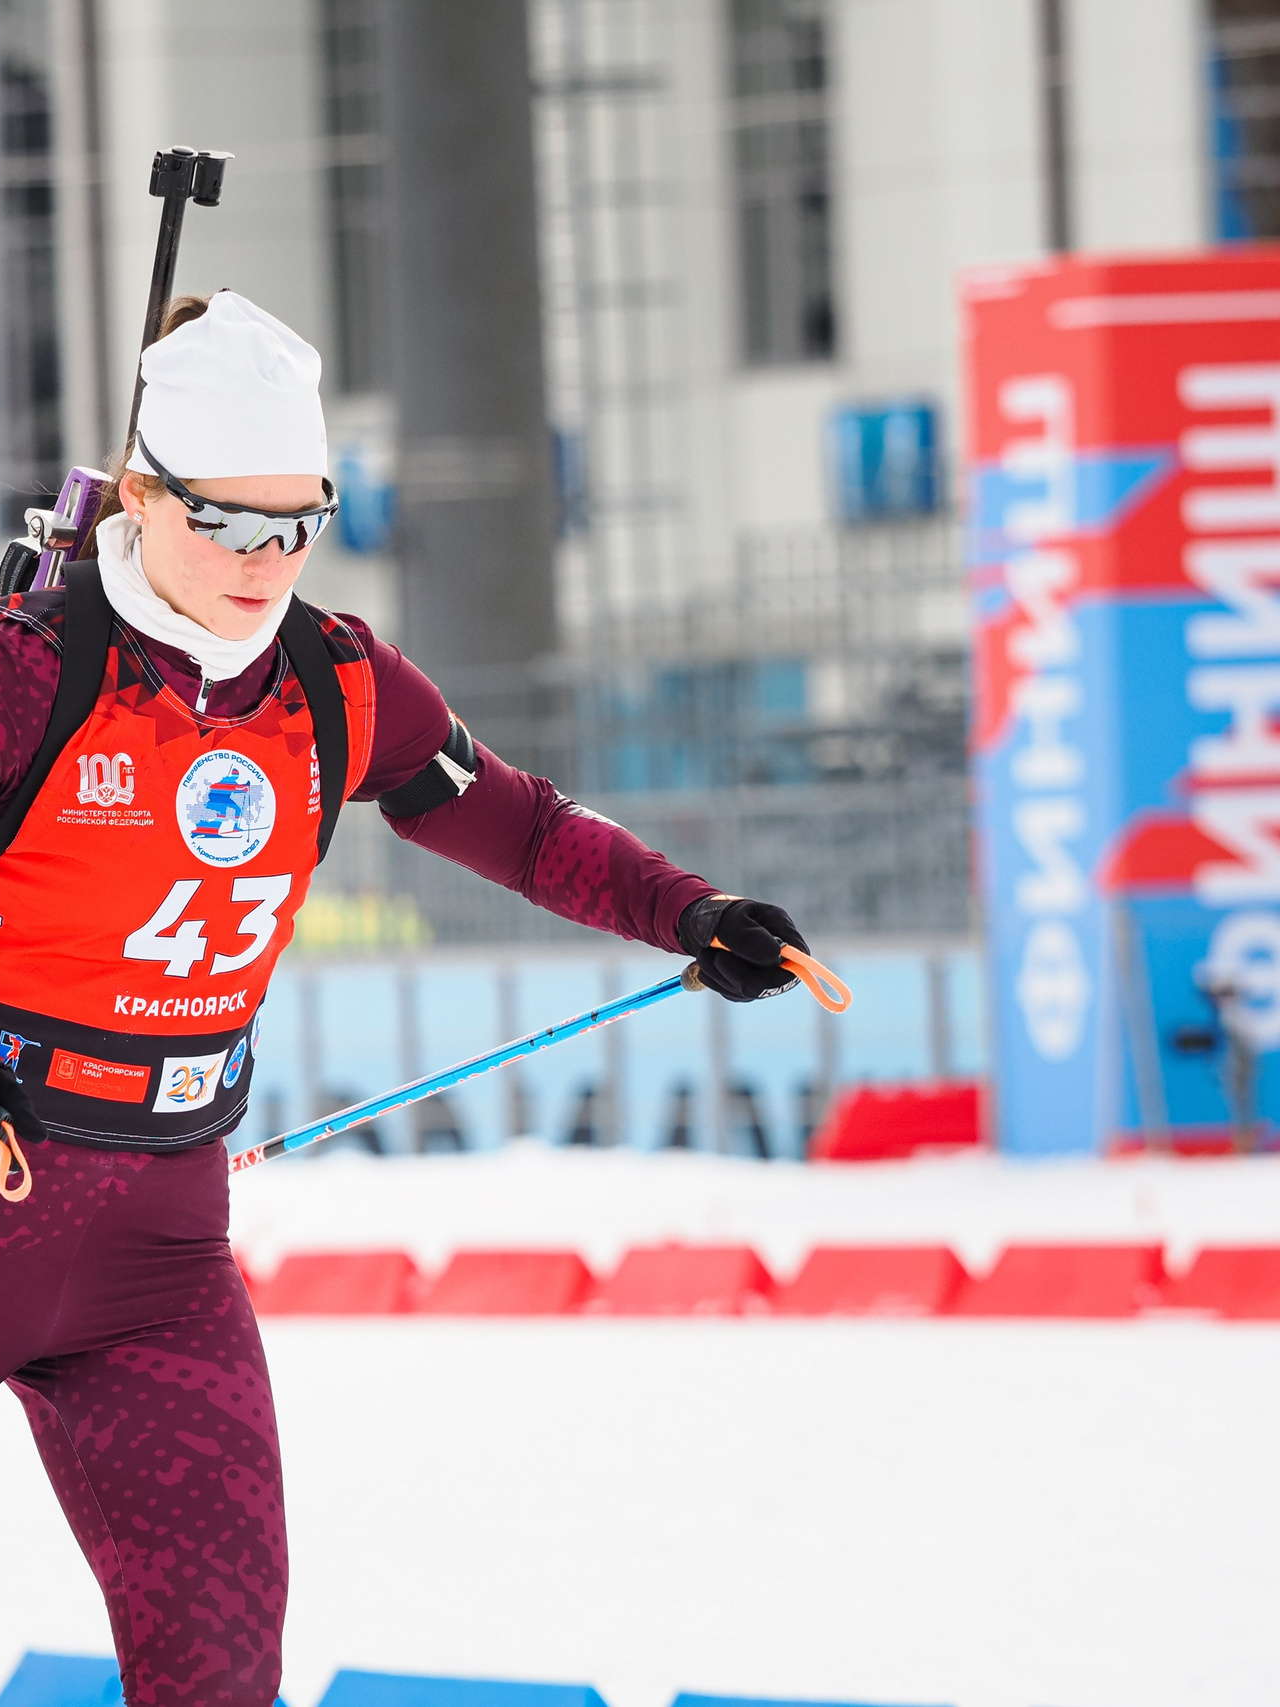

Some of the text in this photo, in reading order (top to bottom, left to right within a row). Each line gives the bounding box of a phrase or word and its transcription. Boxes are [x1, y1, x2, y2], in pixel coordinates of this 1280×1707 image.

[182, 752, 265, 788] ПЕРВЕНСТВО РОССИИ
[56, 816, 154, 826] РОССИЙСКОЙ ФЕДЕРАЦИИ
[62, 808, 121, 817] МИНИСТЕРСТВО
[196, 845, 240, 863] Красноярск
[241, 838, 261, 857] 2023
[122, 872, 293, 979] 43
[113, 988, 249, 1018] КРАСНОЯРСК
[81, 1068, 103, 1079] КРАЙ
[83, 1060, 145, 1078] КРАСНОЯРСКИЙ
